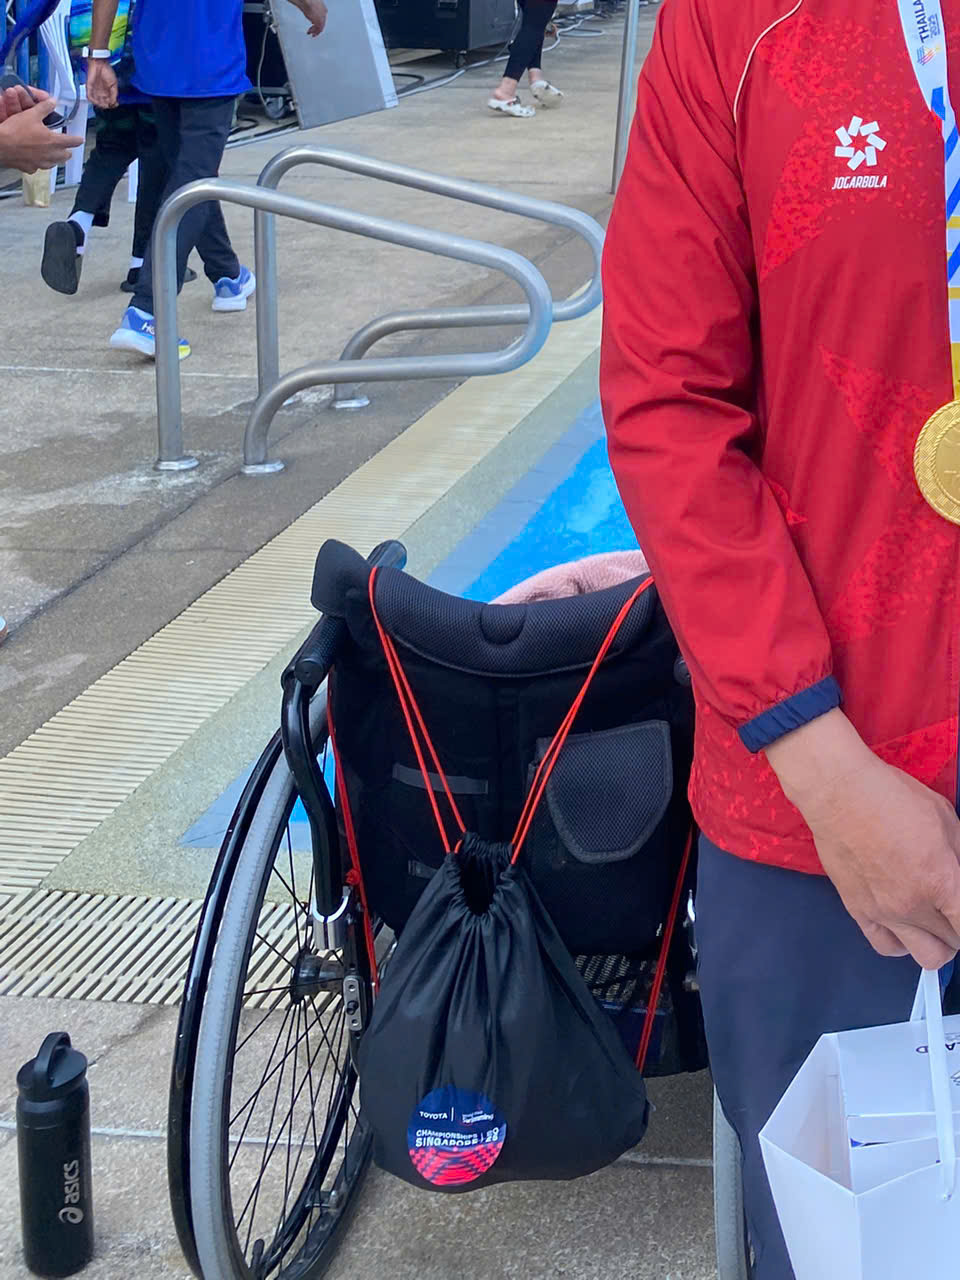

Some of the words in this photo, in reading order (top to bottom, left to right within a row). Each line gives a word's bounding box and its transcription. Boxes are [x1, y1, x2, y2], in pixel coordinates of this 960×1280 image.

[832, 175, 888, 190] JOGARBOLA
[419, 1111, 448, 1120] TOYOTA
[63, 1160, 80, 1204] asics
